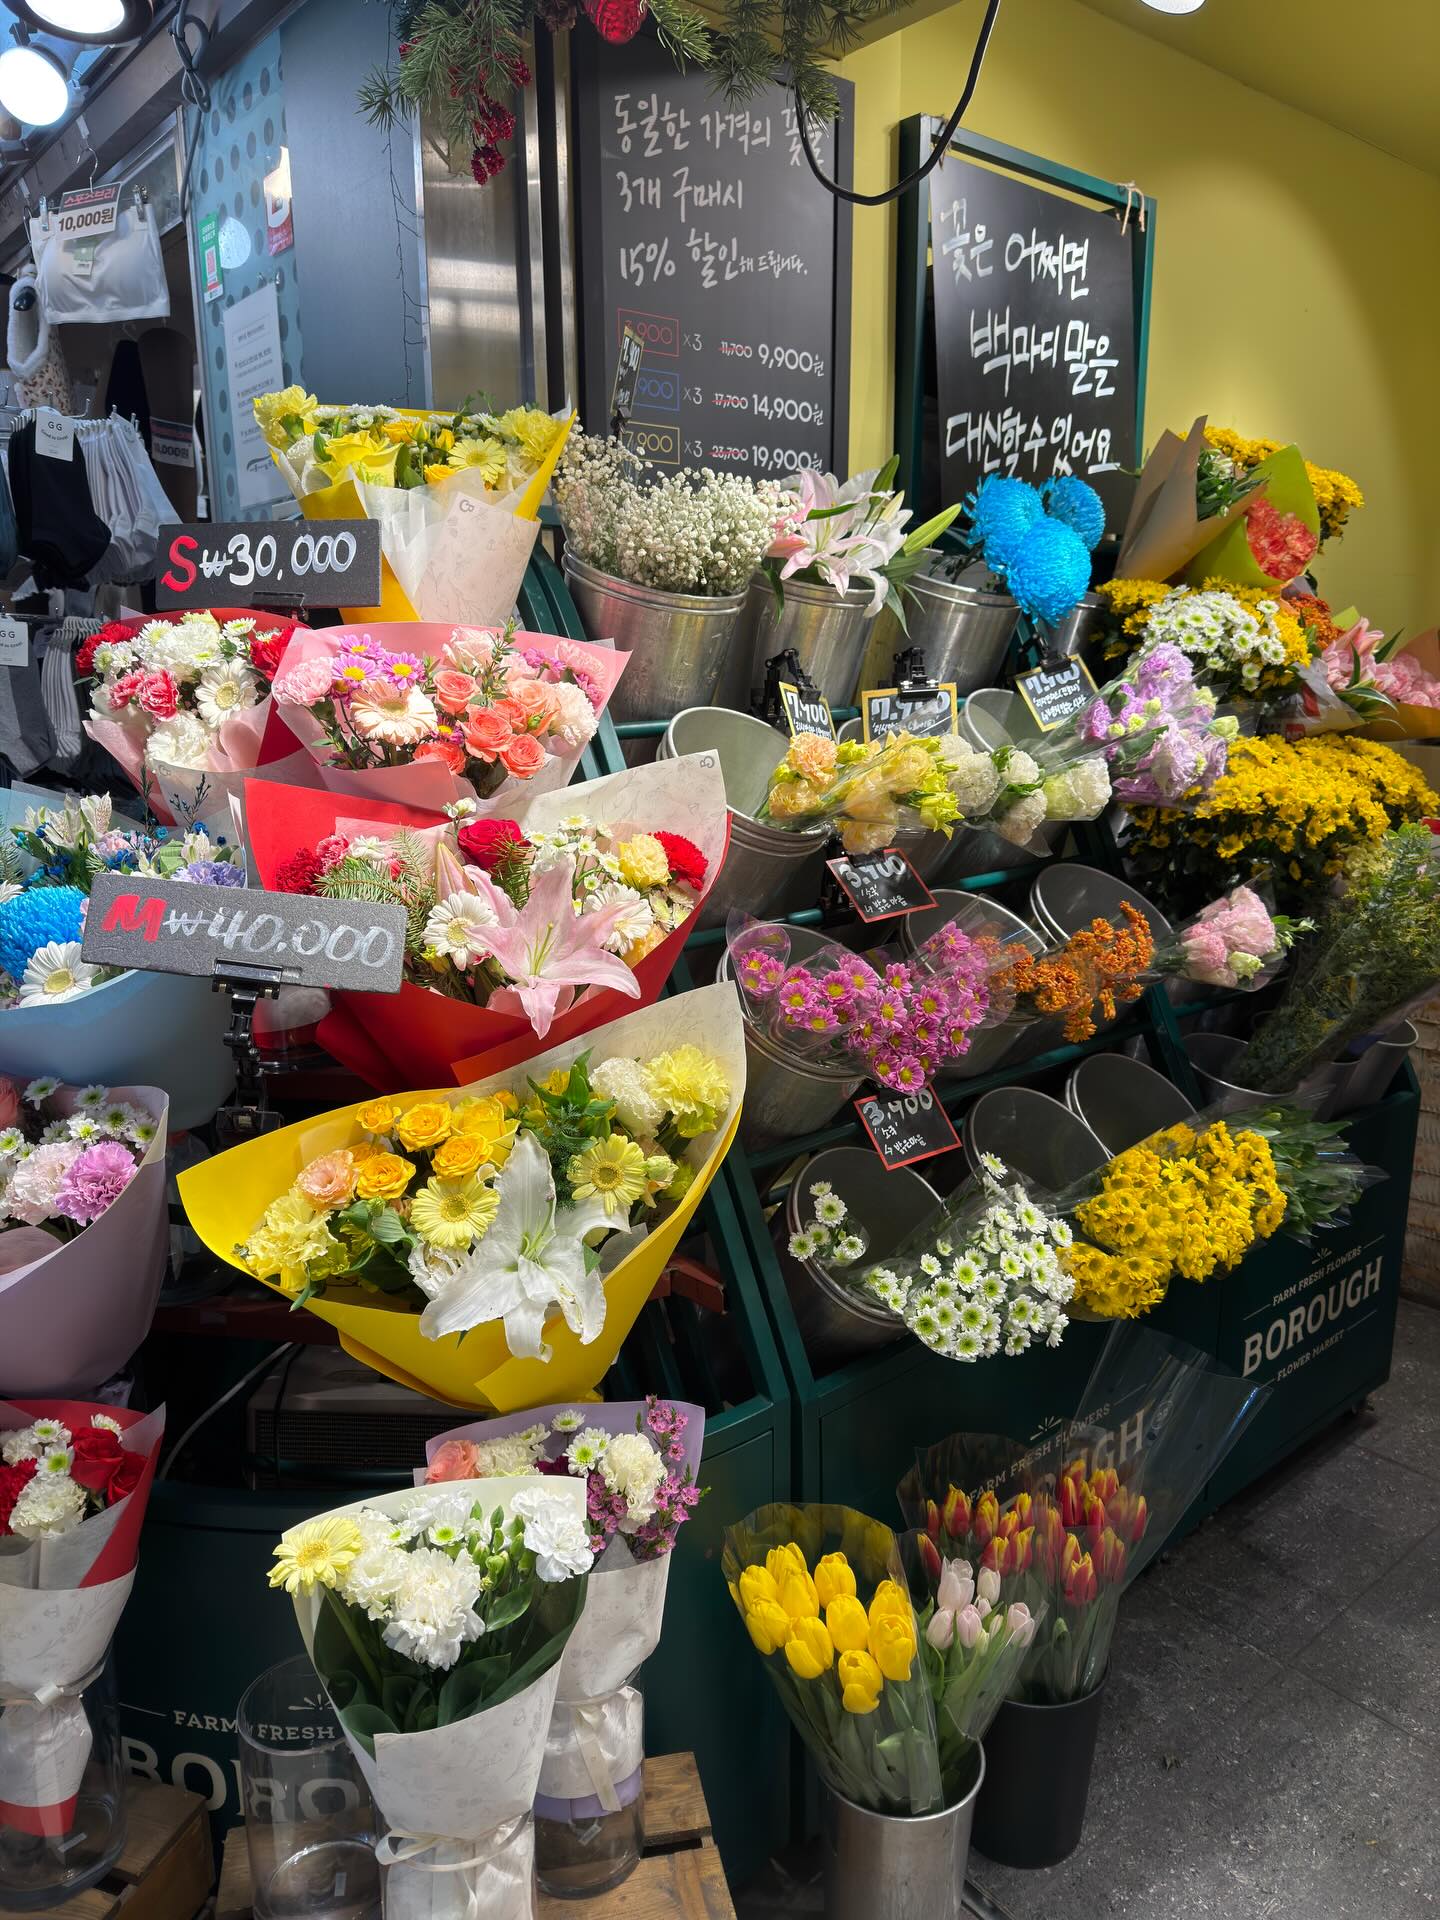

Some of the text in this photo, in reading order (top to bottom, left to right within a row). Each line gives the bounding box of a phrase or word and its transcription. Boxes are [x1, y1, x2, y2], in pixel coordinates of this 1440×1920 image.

[614, 94, 690, 157] 동일한
[700, 111, 770, 155] 가격의
[59, 207, 114, 231] 10,000원
[616, 166, 742, 223] 3개 구매시
[620, 238, 676, 286] 15%
[940, 198, 1089, 300] 꽃은 어쩌면
[624, 320, 673, 344] 900
[758, 344, 825, 377] 9,900원
[970, 306, 1119, 398] 백마디 말을
[752, 394, 824, 426] 14,900원
[624, 430, 673, 453] 7900
[161, 531, 357, 593] S ₩30,000
[102, 894, 168, 943] M
[1272, 1246, 1362, 1306] FARM FRESH FLOWERS
[1242, 1256, 1383, 1378] BOROUGH
[1277, 1329, 1345, 1382] FLOWER MARKET
[1010, 1443, 1051, 1477] FRESH
[1055, 1403, 1110, 1448] FLOWERS
[173, 1711, 335, 1742] FARM FRESH
